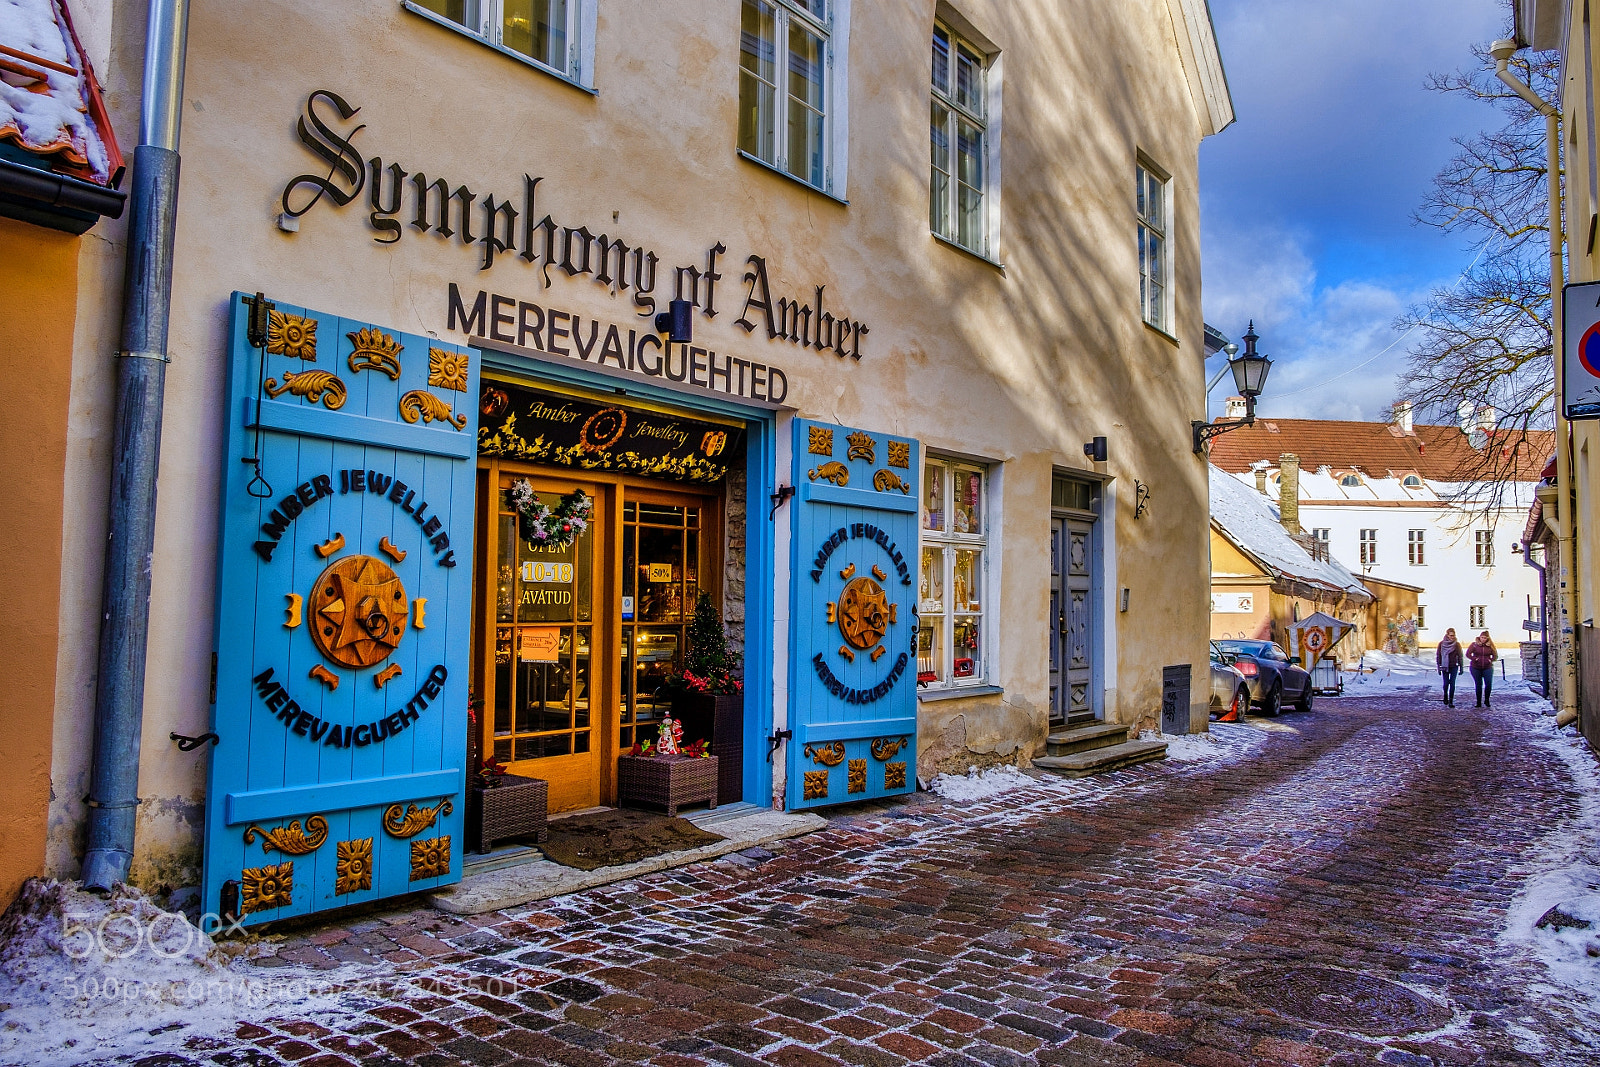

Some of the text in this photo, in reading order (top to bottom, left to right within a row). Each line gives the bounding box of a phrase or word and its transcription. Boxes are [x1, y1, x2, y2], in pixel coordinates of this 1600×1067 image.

[282, 89, 871, 361] Symphony of Amber
[447, 282, 789, 404] MEREVAIGUEHTED
[527, 401, 689, 449] Amber Jewellery
[254, 469, 457, 568] AMBER JEWELLERY
[525, 562, 571, 583] 10-18
[651, 568, 670, 578] -50%
[810, 523, 912, 586] AMBER JEWELLERY
[522, 590, 572, 605] AVATUD
[254, 664, 448, 748] MEREVAIGUEHTED
[813, 652, 909, 705] MEREVAIGUEHTED
